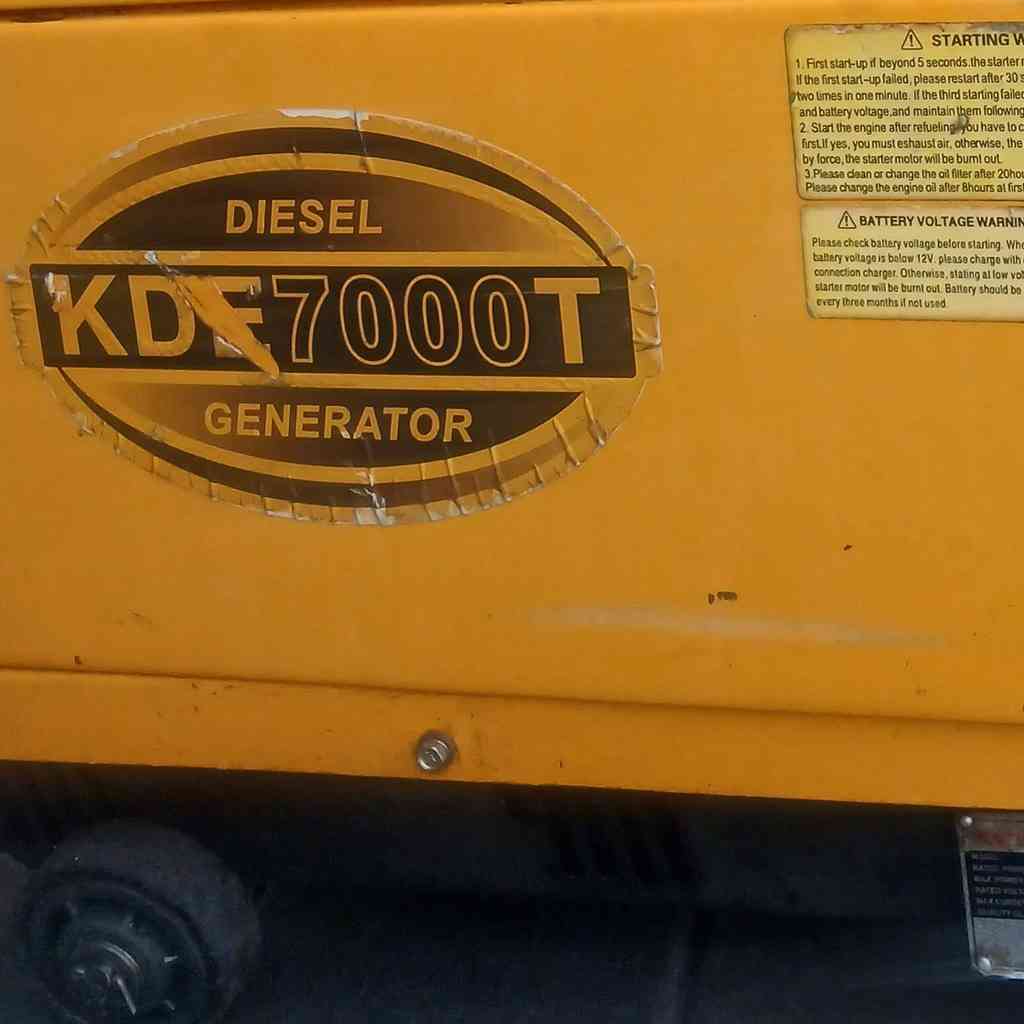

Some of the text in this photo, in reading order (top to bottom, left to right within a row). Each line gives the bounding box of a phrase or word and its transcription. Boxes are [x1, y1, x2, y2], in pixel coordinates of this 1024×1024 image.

[932, 34, 1009, 47] STARTING
[807, 58, 827, 69] First
[830, 58, 867, 70] start-up
[880, 57, 915, 71] beyond
[918, 57, 924, 68] 5
[988, 57, 1019, 67] starter
[805, 74, 819, 85] the
[822, 74, 840, 85] first
[842, 74, 880, 87] start-up
[914, 73, 945, 86] please
[948, 73, 979, 84] restart
[981, 73, 1002, 84] after
[1006, 72, 1018, 83] 30
[797, 92, 814, 101] two
[816, 92, 842, 101] times
[922, 90, 937, 100] the
[939, 90, 960, 100] third
[963, 90, 999, 102] starting
[800, 107, 817, 117] and
[819, 106, 851, 119] battery
[914, 105, 955, 116] maintain
[984, 105, 1024, 118] following
[811, 123, 834, 133] Start
[837, 123, 851, 133] the
[854, 123, 886, 135] engine
[889, 122, 911, 133] after
[981, 122, 1005, 132] have
[1007, 122, 1017, 132] to
[852, 141, 870, 151] you
[872, 140, 895, 149] must
[897, 138, 935, 149] eshaust
[1007, 138, 1023, 148] the
[803, 154, 1003, 166] by the starter motor will be burnt out.
[847, 169, 871, 178] clean
[874, 170, 883, 178] or
[885, 169, 920, 181] change
[922, 169, 936, 178] the
[938, 169, 950, 178] oil
[952, 169, 972, 178] filter
[975, 169, 995, 178] after
[805, 182, 837, 192] Please
[840, 183, 873, 195] change
[876, 183, 890, 192] the
[893, 183, 924, 195] engine
[926, 183, 936, 192] oil
[939, 183, 959, 192] after
[962, 183, 994, 192] 8hours
[997, 183, 1006, 192] at
[224, 198, 385, 236] DIESEL
[860, 216, 914, 227] BATTERY
[918, 217, 975, 227] VOLTAGE
[812, 238, 842, 248] Please
[844, 238, 869, 248] check
[871, 239, 901, 250] battery
[903, 239, 936, 251] voltage
[937, 239, 966, 249] before
[813, 253, 842, 265] battery
[845, 254, 877, 265] voltage
[888, 254, 914, 264] below
[938, 255, 968, 267] please
[970, 255, 1000, 266] charge
[1003, 255, 1021, 265] with
[814, 268, 861, 277] connection
[950, 269, 980, 281] stating
[982, 270, 991, 279] at
[815, 284, 843, 293] starter
[845, 284, 870, 293] motor
[872, 284, 886, 293] will
[888, 284, 899, 293] be
[901, 284, 924, 294] burnt
[945, 285, 976, 296] Battery
[979, 285, 1008, 295] should
[1010, 286, 1021, 295] be
[817, 298, 922, 308] every three months not
[203, 401, 474, 444] GENERATOR
